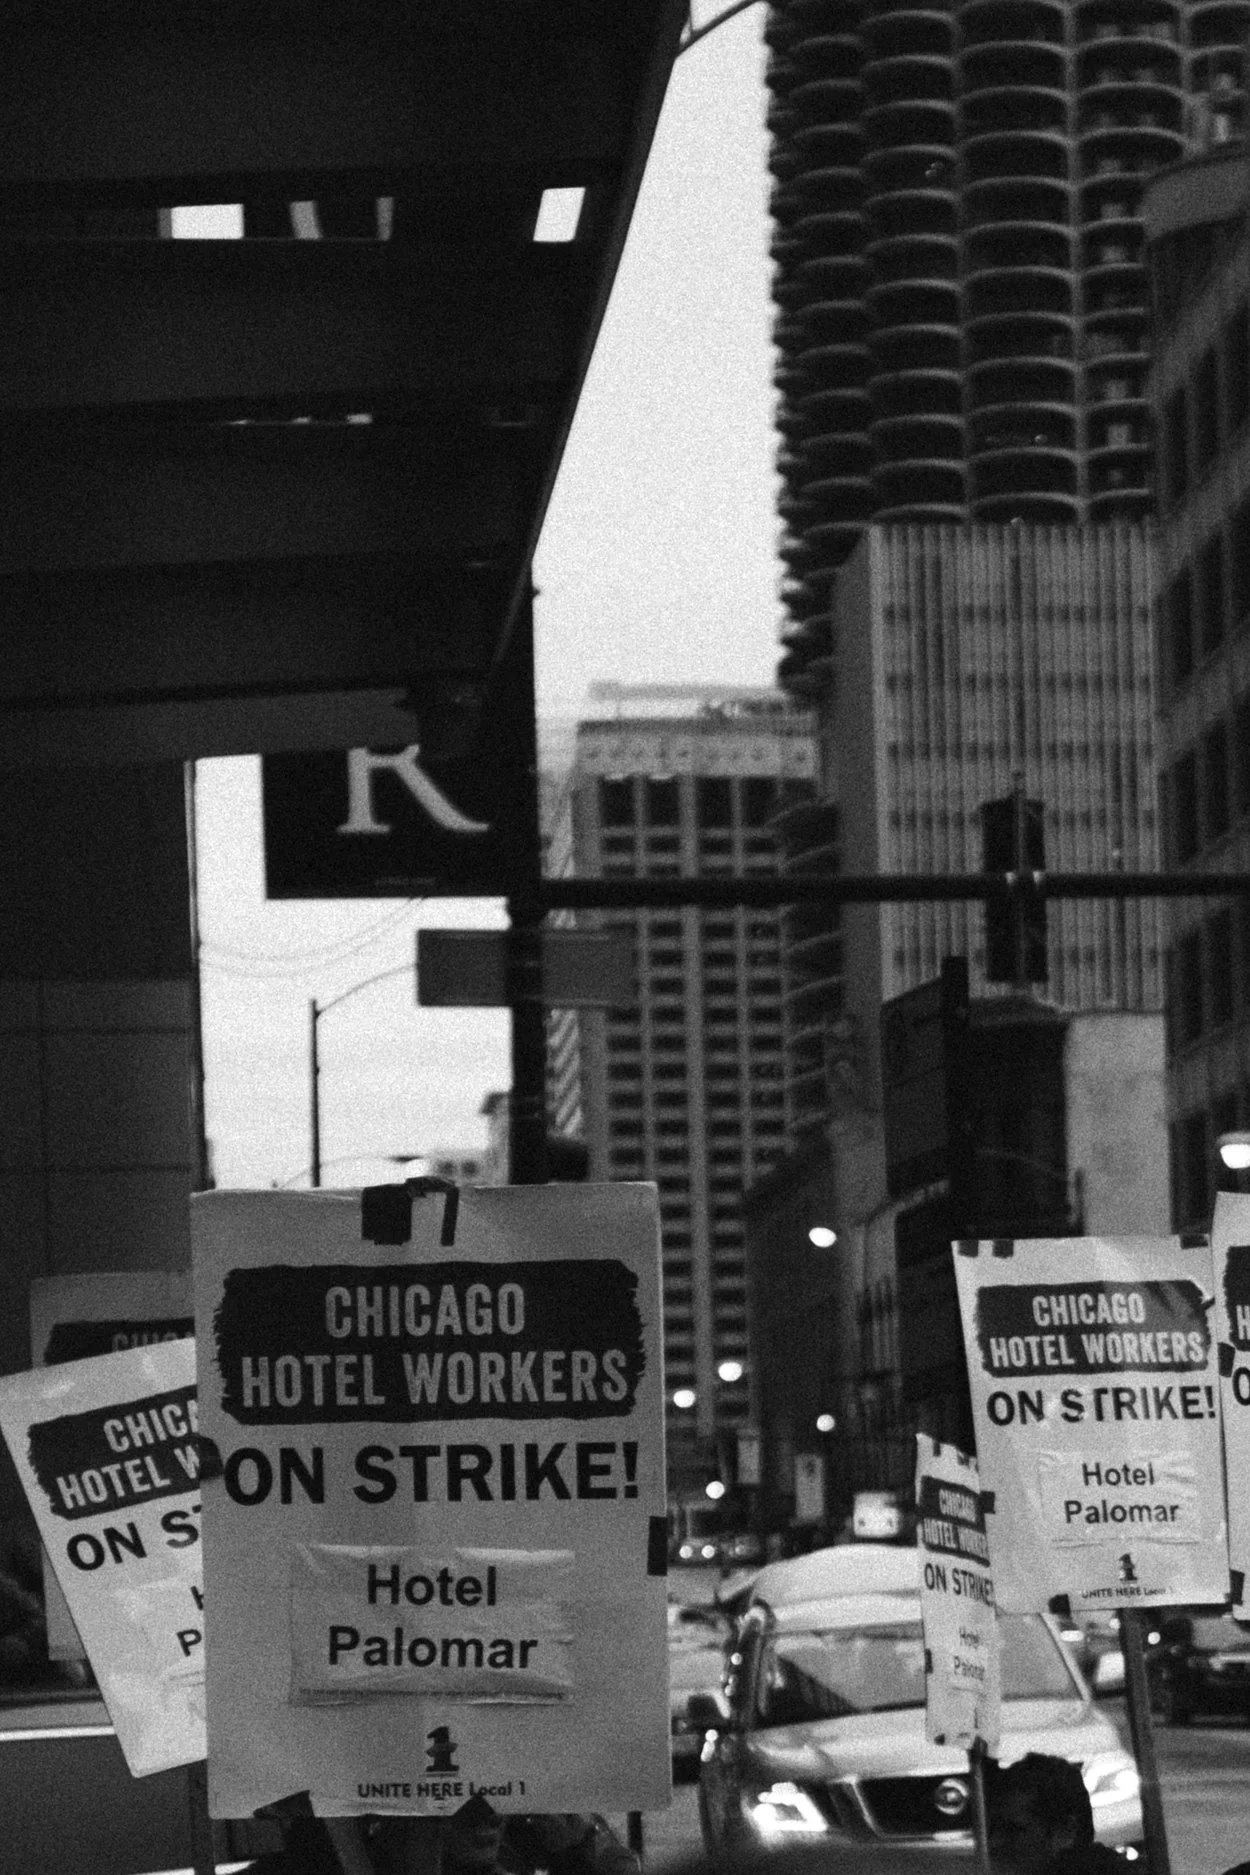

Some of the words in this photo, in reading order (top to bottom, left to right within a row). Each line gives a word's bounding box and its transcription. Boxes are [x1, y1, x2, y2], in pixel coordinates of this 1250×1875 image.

[325, 1283, 525, 1337] CHICAGO
[1032, 1292, 1146, 1327] CHICAGO
[989, 1334, 1075, 1368] HOTEL
[1080, 1331, 1205, 1365] WORKERS
[242, 1354, 384, 1407] HOTEL
[402, 1349, 628, 1404] WORKERS
[986, 1389, 1045, 1426] ON
[1060, 1385, 1216, 1423] STRIKE!
[104, 1400, 198, 1453] CHIC
[56, 1455, 170, 1510] HOTEL
[224, 1446, 324, 1505] ON
[354, 1441, 639, 1503] STRIKE!
[1082, 1462, 1155, 1486] Hotel
[1064, 1499, 1179, 1524] Palomar
[66, 1522, 147, 1571] ON
[367, 1564, 497, 1606] Hotel
[924, 1563, 947, 1592] ON
[1081, 1587, 1113, 1599] UNITE
[1115, 1585, 1141, 1597] HERE
[328, 1626, 537, 1669] Palomar
[358, 1783, 411, 1798] UNITE
[417, 1782, 463, 1797] HERE
[469, 1781, 512, 1797] Local
[519, 1781, 526, 1796] 1
